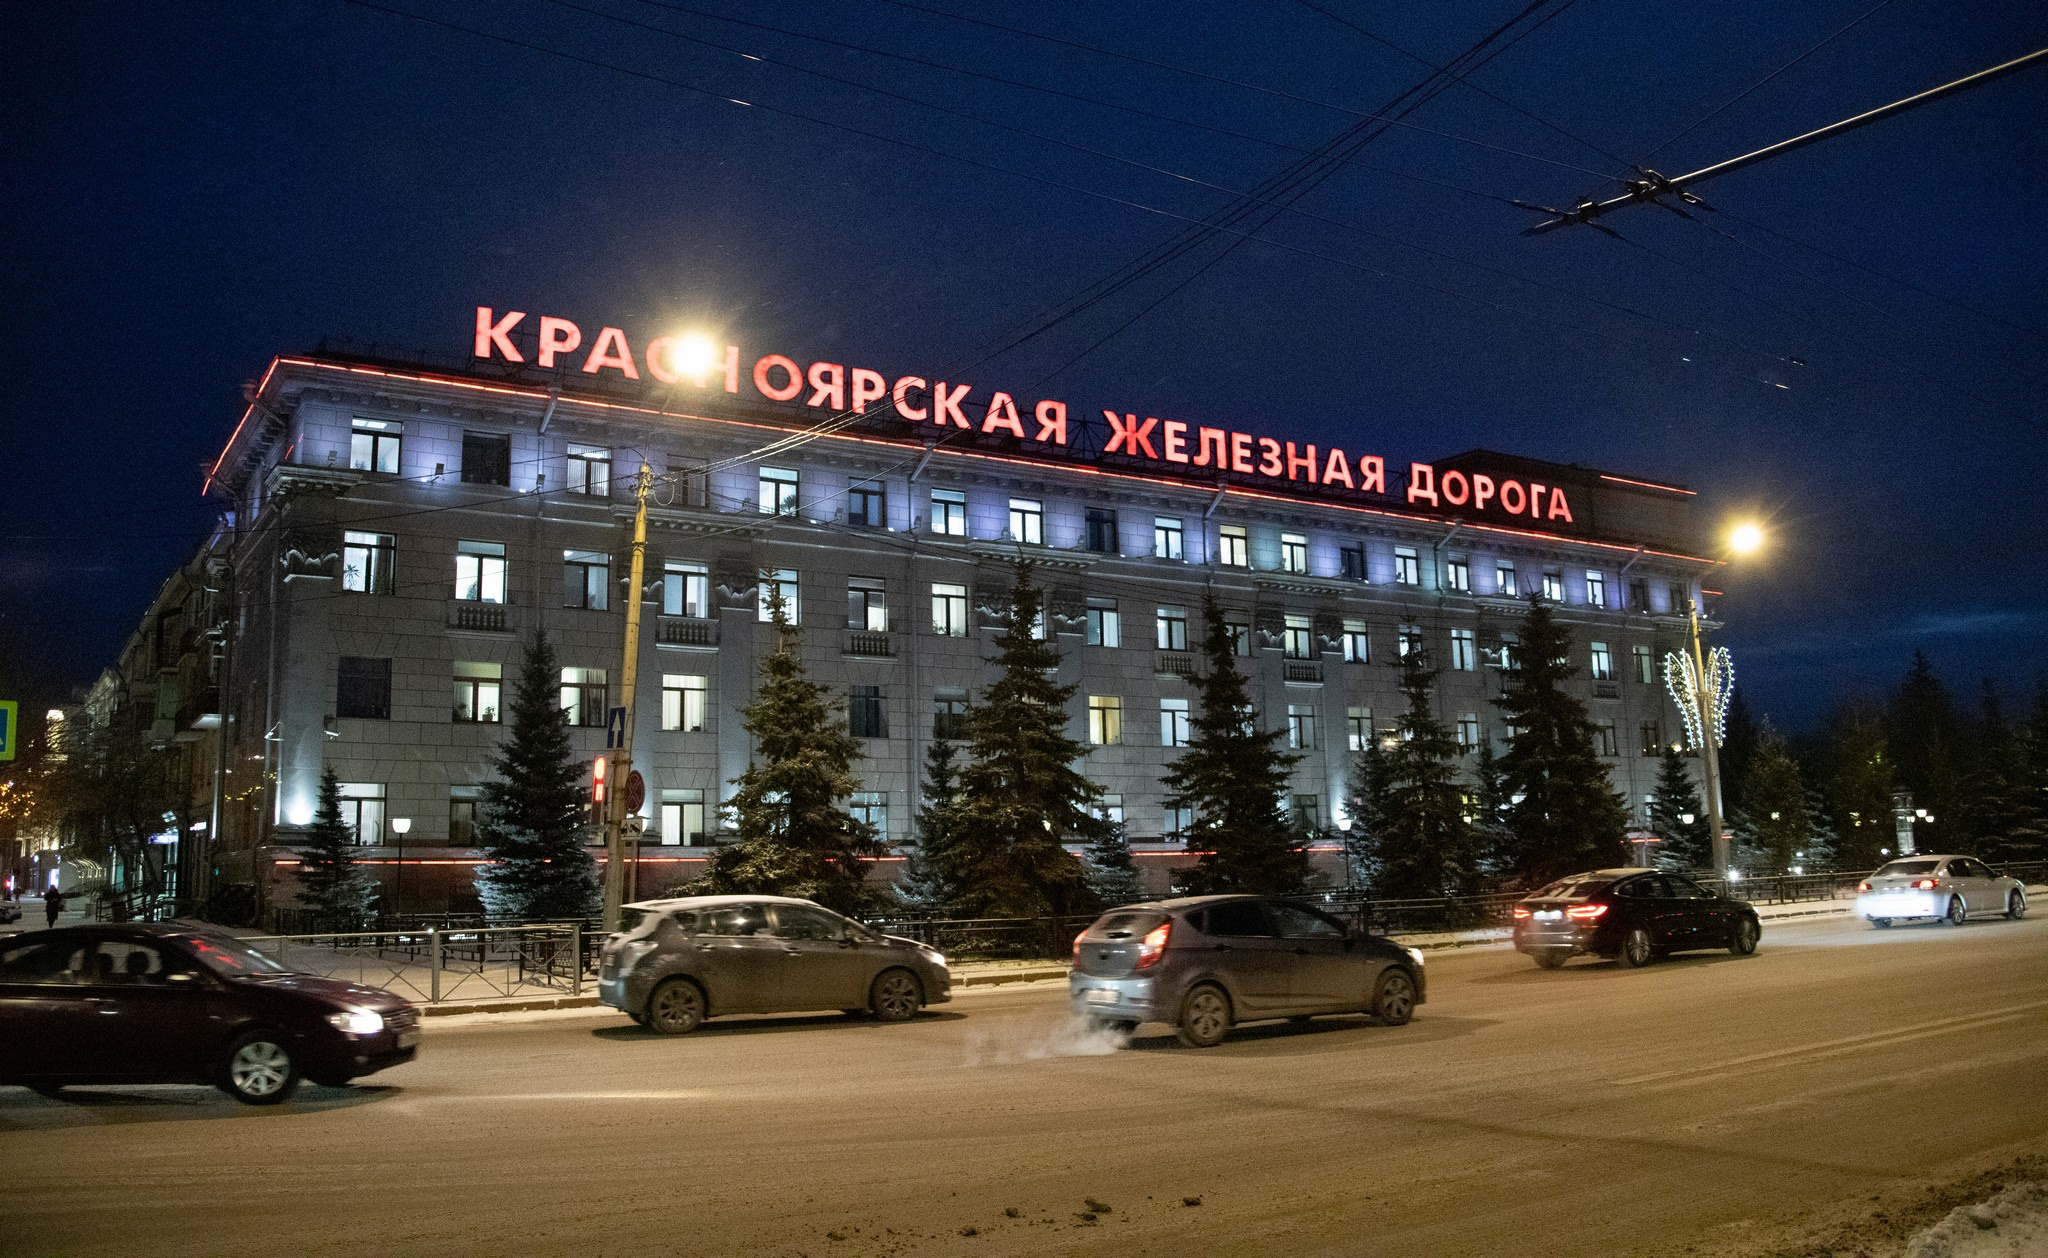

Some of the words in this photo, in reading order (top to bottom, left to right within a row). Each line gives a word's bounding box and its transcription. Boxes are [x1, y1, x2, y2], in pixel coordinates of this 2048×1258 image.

[474, 306, 1067, 445] КРАСНОЯРСКАЯ
[1103, 410, 1385, 494] ЖЕЛЕЗНАЯ
[1407, 462, 1573, 523] ДОРОГА
